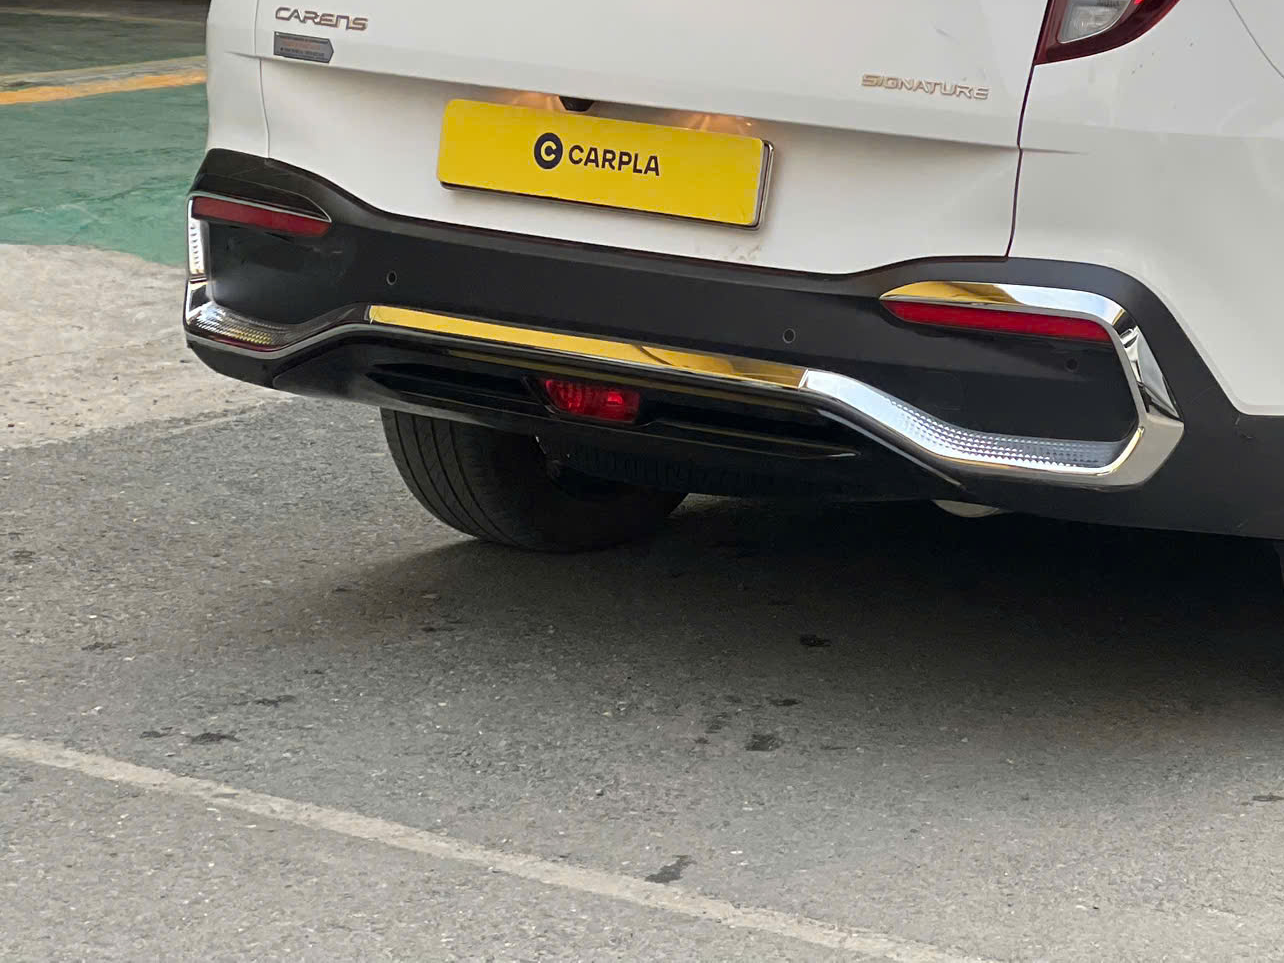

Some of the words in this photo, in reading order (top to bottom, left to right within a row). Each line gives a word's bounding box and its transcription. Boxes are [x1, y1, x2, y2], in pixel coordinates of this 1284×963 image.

[275, 7, 368, 30] CARENS
[861, 74, 989, 100] SIGNATURE
[568, 144, 660, 176] CARPLA
